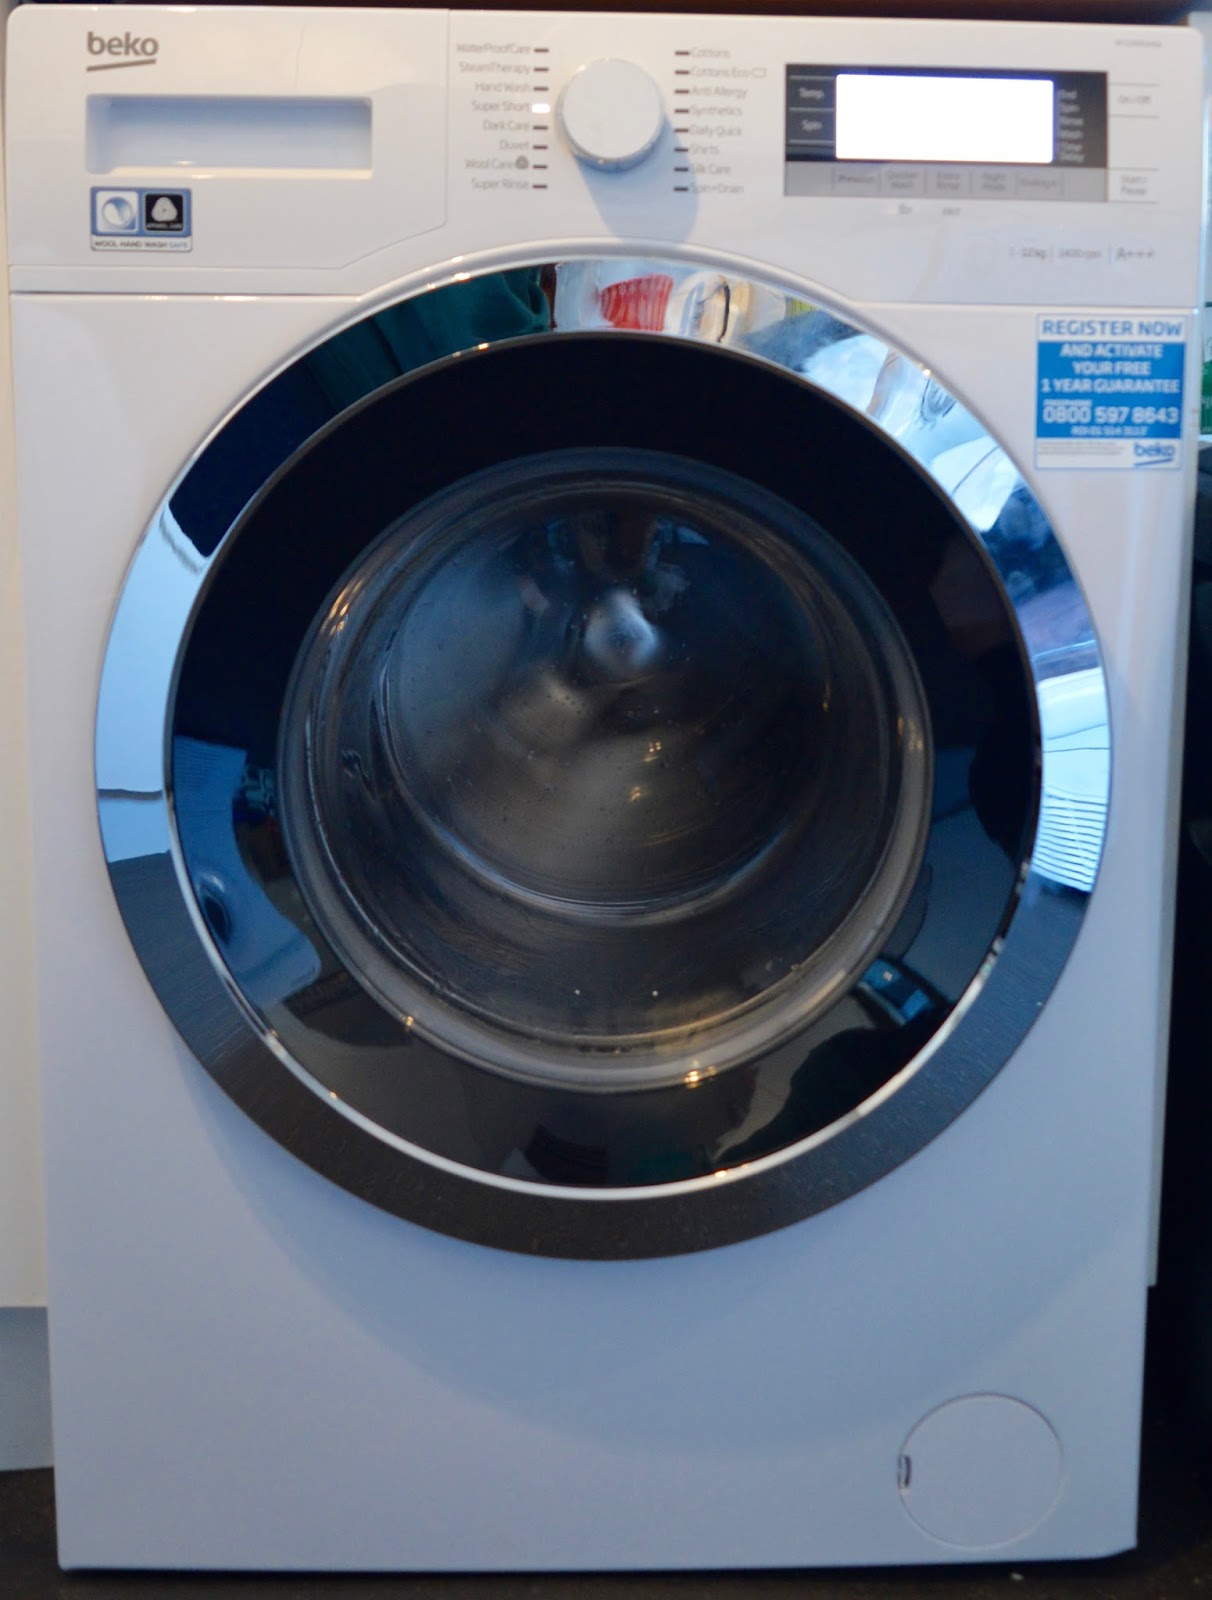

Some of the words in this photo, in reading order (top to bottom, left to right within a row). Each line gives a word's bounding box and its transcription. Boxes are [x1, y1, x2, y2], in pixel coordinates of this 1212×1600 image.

[87, 31, 159, 56] beko
[456, 43, 531, 54] WaterProofCare
[459, 61, 531, 74] SteamTherapy
[475, 82, 501, 92] Hand
[504, 82, 530, 92] Wash
[472, 100, 499, 112] Super
[502, 101, 530, 111] Short
[690, 104, 742, 117] Synthetics
[483, 120, 505, 131] Dark
[507, 120, 529, 131] Care
[716, 125, 742, 137] Quick
[499, 140, 529, 150] Duvet
[465, 158, 489, 169] Wool
[491, 159, 514, 169] Care
[709, 164, 731, 175] Care
[471, 178, 499, 190] Super
[502, 179, 529, 189] Rinse
[1042, 319, 1133, 335] REGISTER
[1138, 320, 1182, 336] NOW
[1059, 343, 1093, 358] AND
[1094, 343, 1163, 359] ACTIVATE
[1072, 361, 1113, 375] YOUR
[1115, 361, 1151, 376] FREE
[1041, 378, 1051, 393] 1
[1053, 378, 1092, 392] YEAR
[1093, 378, 1181, 394] GUARANTEE
[1042, 406, 1092, 424] 0800
[1094, 406, 1130, 424] 597
[1131, 406, 1179, 425] 8643
[1134, 442, 1175, 456] beko
